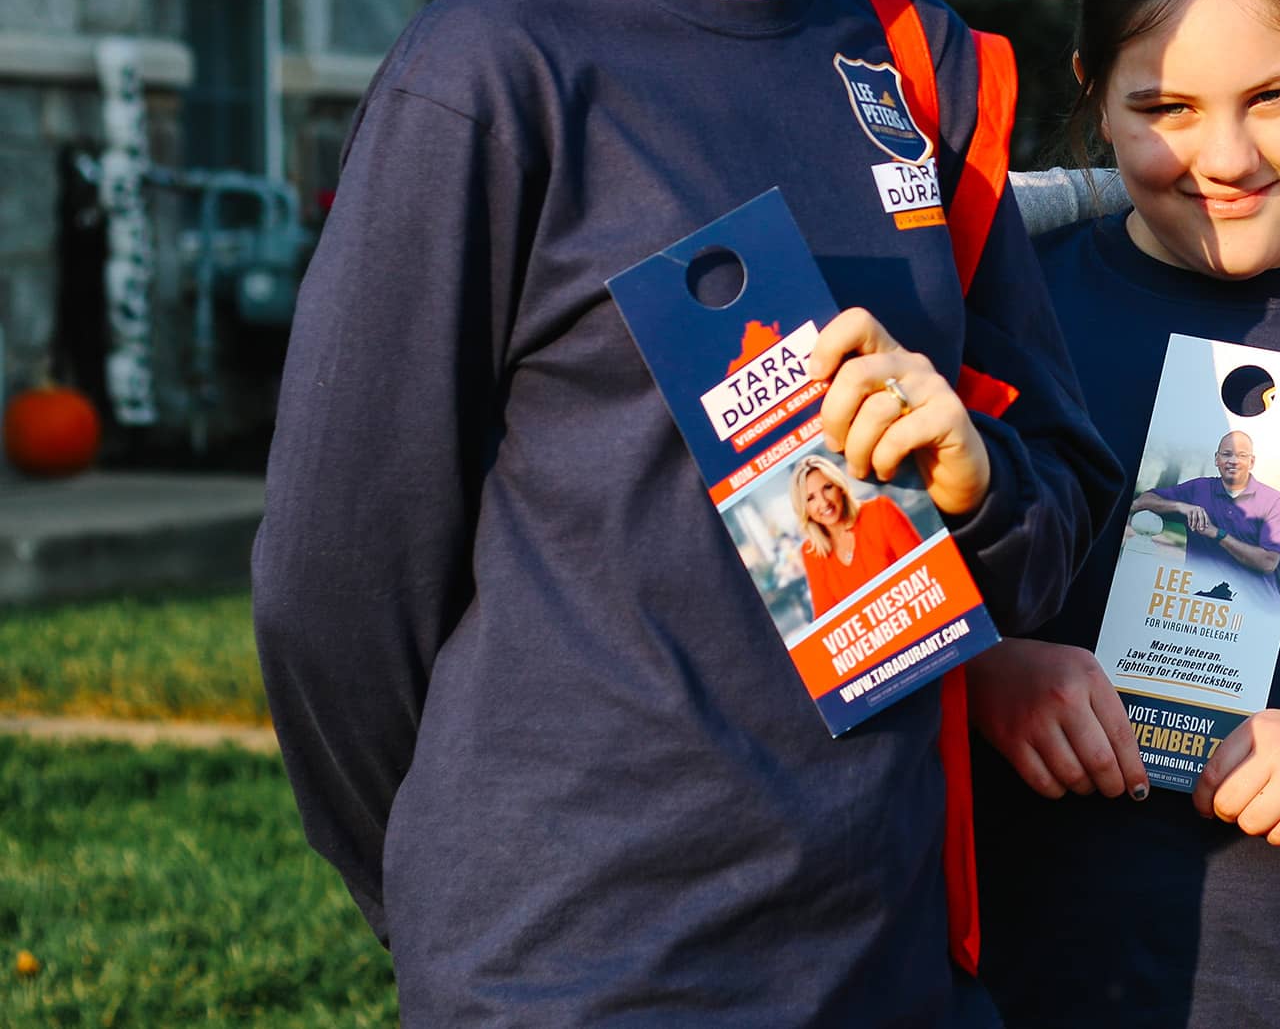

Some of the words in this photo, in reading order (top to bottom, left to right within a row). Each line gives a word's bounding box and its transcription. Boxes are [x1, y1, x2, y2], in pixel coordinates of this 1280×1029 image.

[851, 81, 877, 103] LEE
[861, 103, 904, 131] PETERS
[728, 346, 796, 397] TARA
[722, 353, 811, 428] DURAN
[734, 409, 787, 446] VIRGINIA
[1154, 566, 1193, 594] LEE
[821, 614, 867, 656] VOTE
[862, 565, 937, 626] TUESDAY,
[1147, 593, 1230, 628] PETERS
[831, 610, 913, 676] NOVEMBER
[908, 583, 947, 620] 7TH!
[1145, 617, 1160, 628] FOR
[1162, 619, 1198, 635] VIRGINIA
[1200, 627, 1239, 642] DELEGATE
[839, 619, 970, 704] WWW.TARADURANT.COM
[1127, 648, 1146, 659] Law
[1147, 651, 1206, 671] Enforcement
[1207, 661, 1240, 677] Officer.
[1150, 640, 1183, 655] Marine
[1184, 646, 1222, 661] Veteran.
[1117, 659, 1155, 676] Fighting
[1157, 666, 1171, 677] for
[1171, 668, 1244, 692] Fredericksburg.
[1128, 704, 1158, 724] VOTE
[1160, 710, 1215, 735] TUESDAY
[1207, 737, 1224, 759] 7
